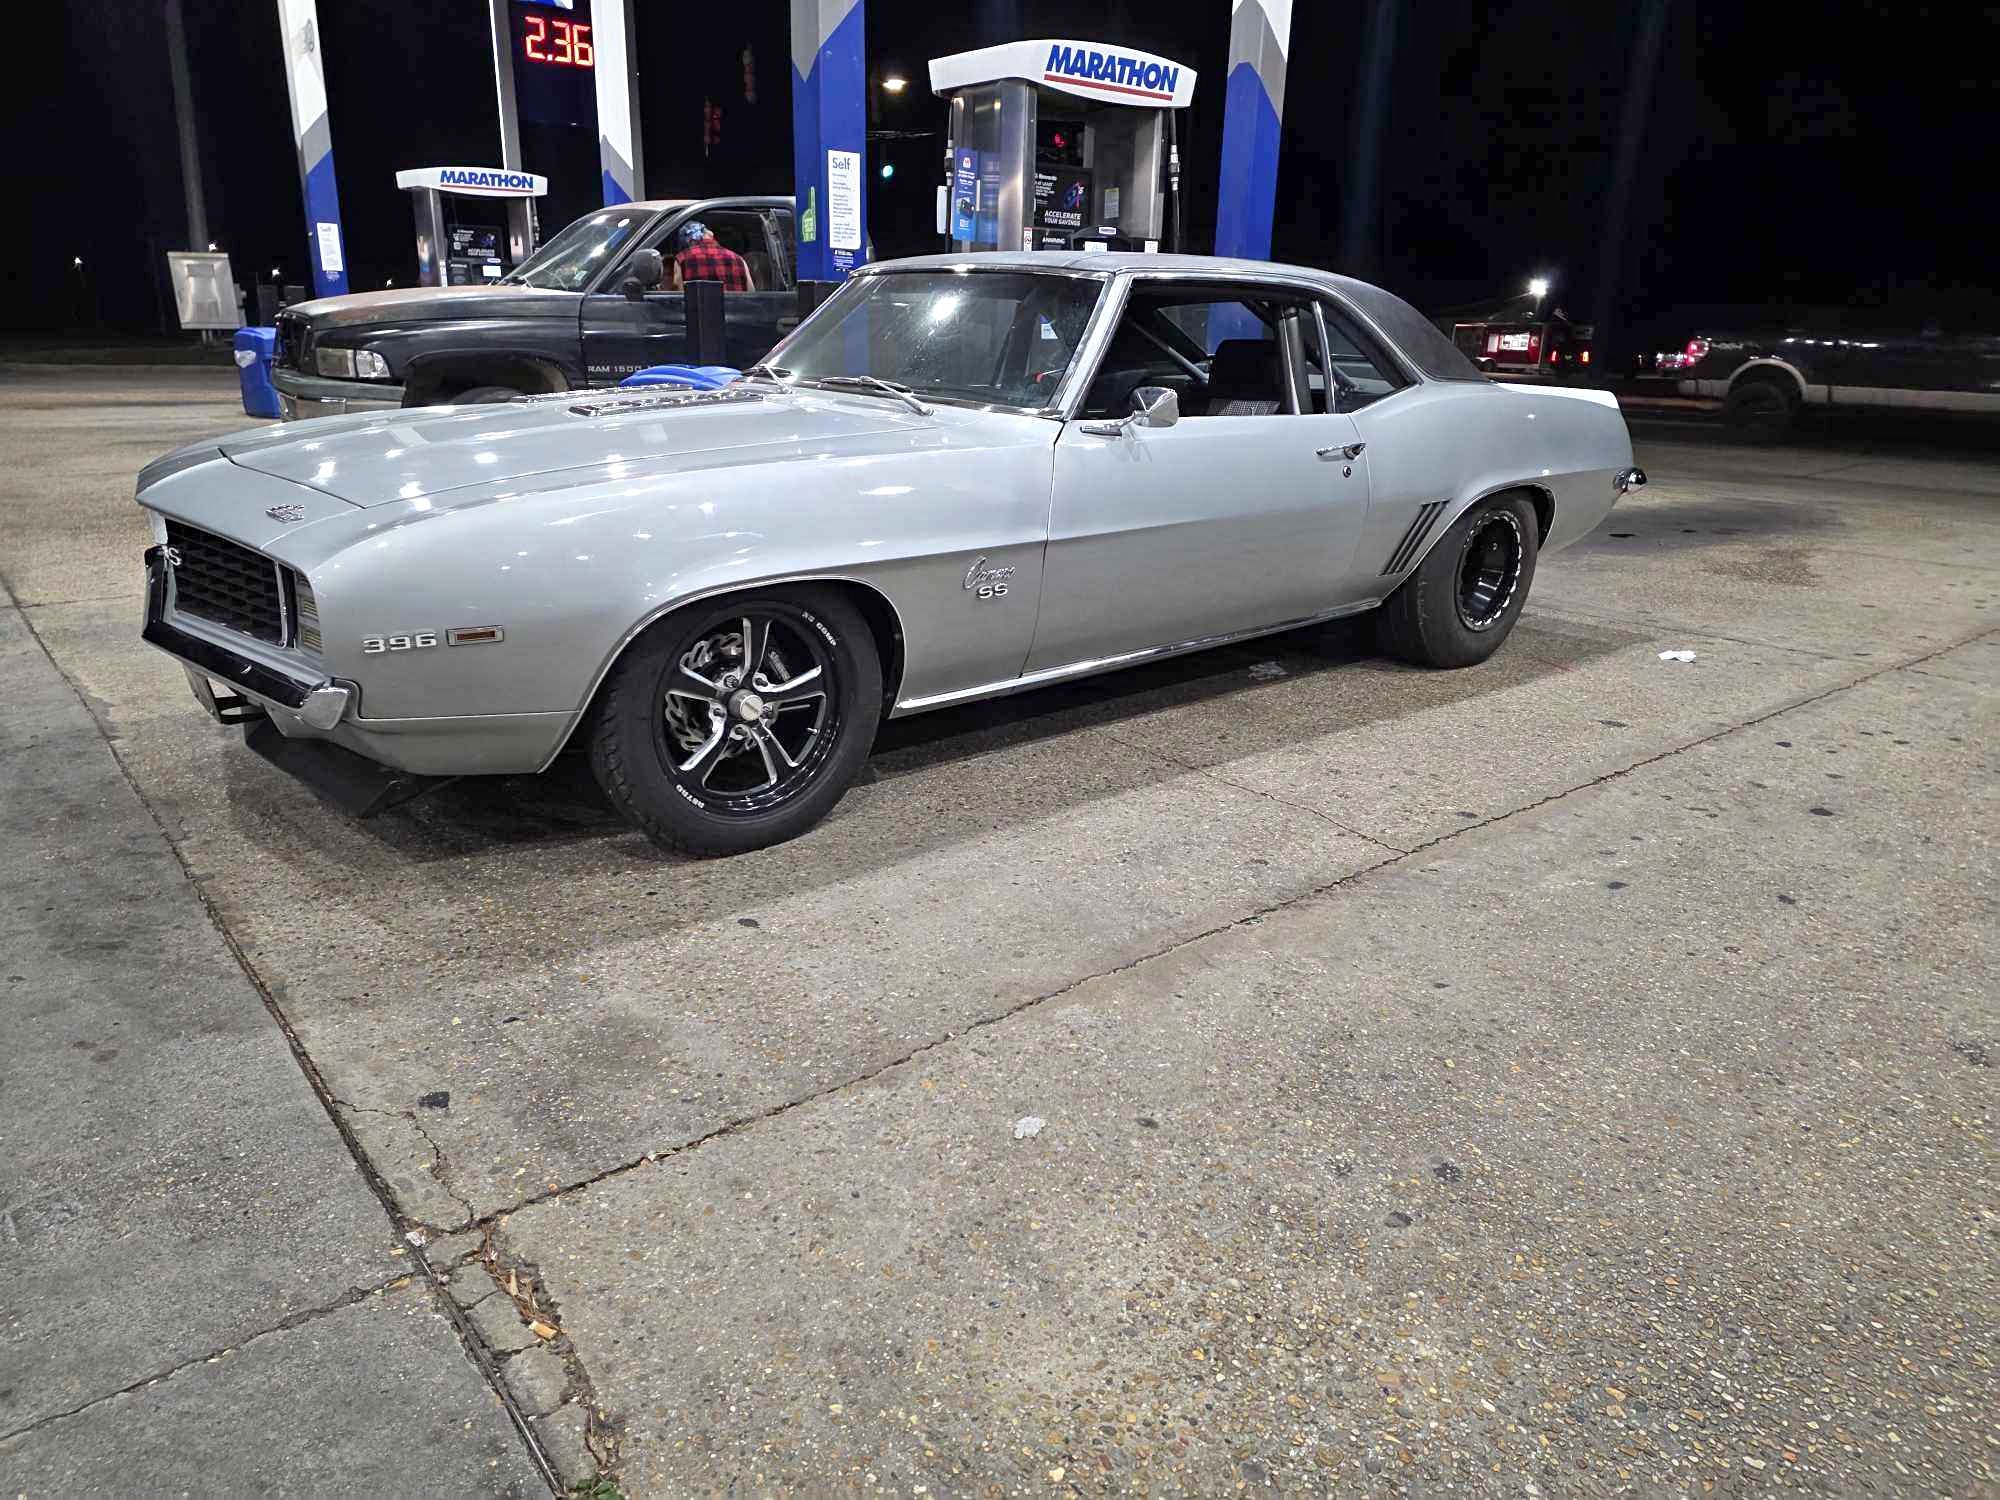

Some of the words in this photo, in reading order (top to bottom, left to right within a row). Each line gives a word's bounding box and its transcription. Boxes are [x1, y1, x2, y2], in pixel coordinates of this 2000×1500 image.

[525, 16, 593, 66] 2.36
[1046, 44, 1179, 93] MARATHON
[832, 157, 851, 170] Self
[440, 170, 533, 189] MARATHON
[1044, 210, 1081, 220] ACCELERATE
[1058, 219, 1081, 227] SAVINGS
[587, 365, 610, 373] RAM
[978, 582, 1008, 599] SS
[363, 633, 437, 654] 396
